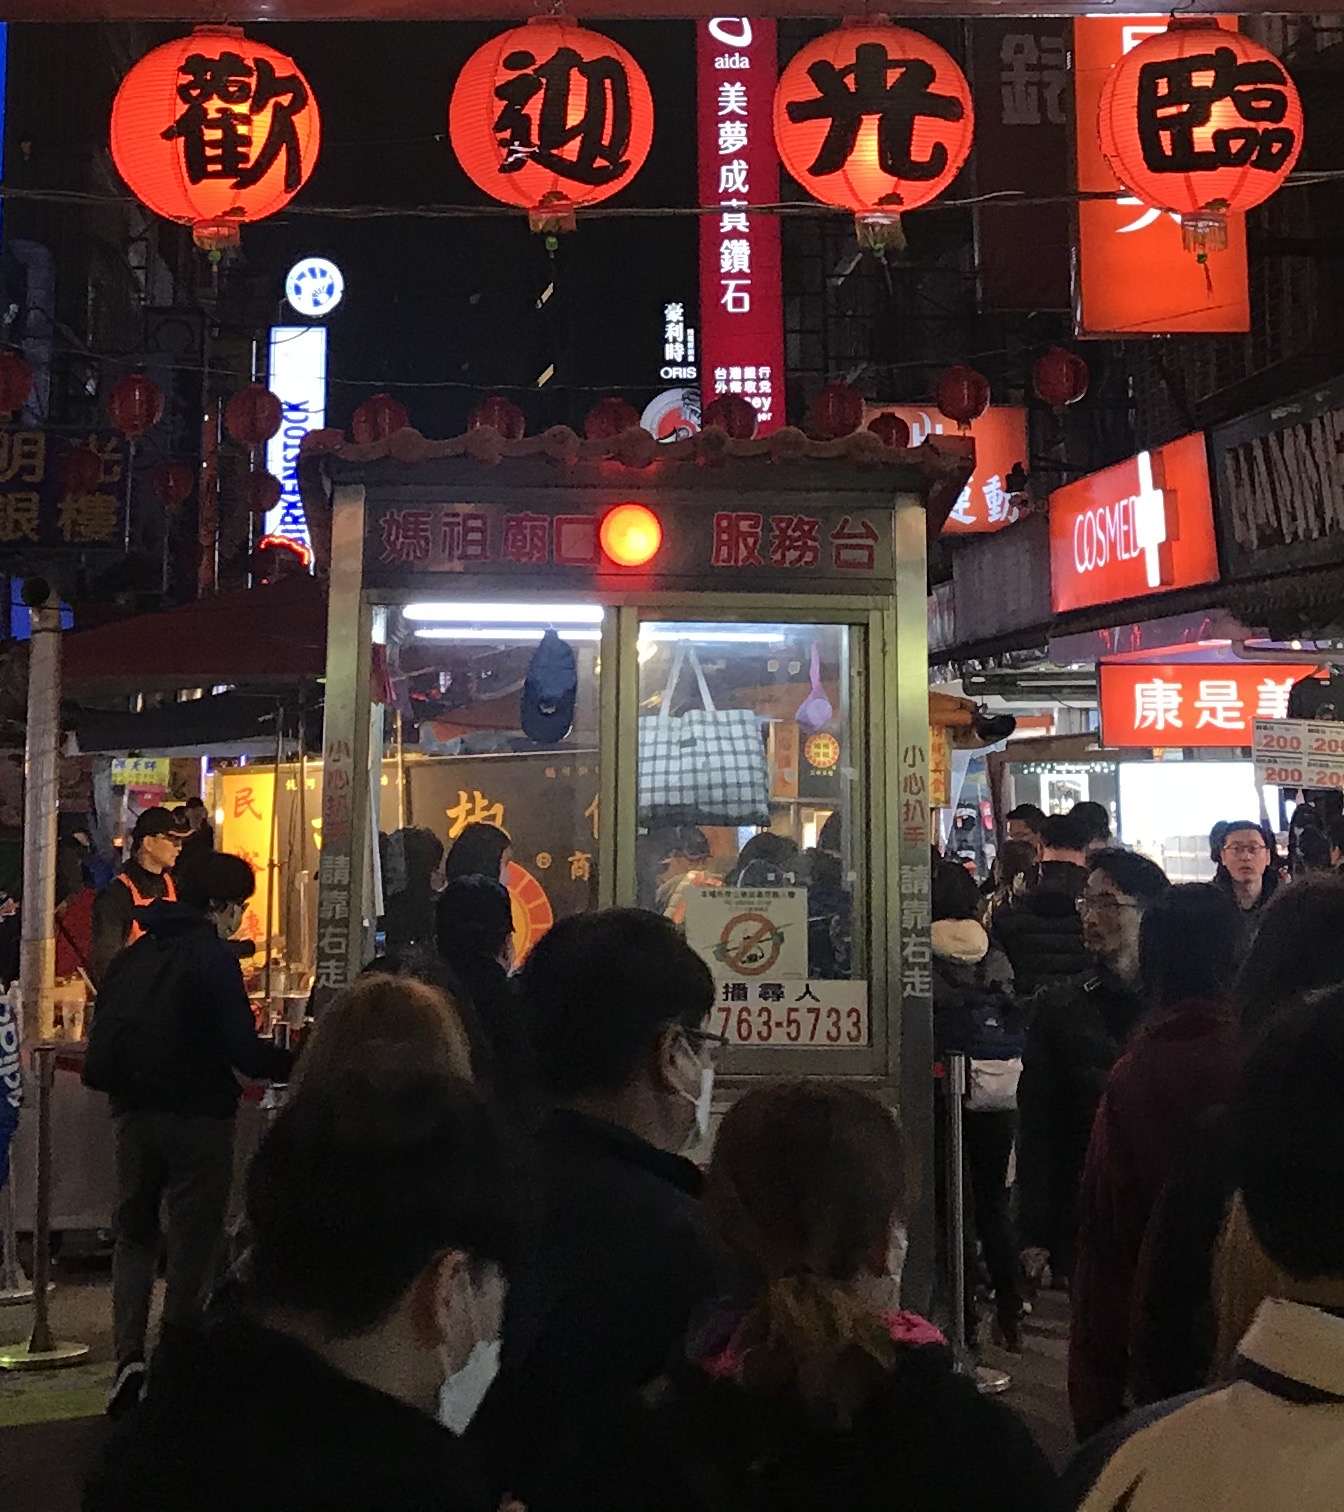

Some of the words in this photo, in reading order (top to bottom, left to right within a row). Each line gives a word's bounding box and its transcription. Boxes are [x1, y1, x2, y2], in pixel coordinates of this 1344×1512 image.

[714, 53, 750, 70] aida
[160, 53, 310, 193] 歡
[494, 48, 632, 186] 迎
[786, 43, 964, 181] 光
[1137, 47, 1296, 174] 臨
[717, 81, 751, 314] 美夢成真鑽石
[660, 366, 697, 379] ORIS
[711, 511, 880, 569] 服務台
[1074, 493, 1143, 574] COSMED
[1262, 734, 1302, 751] 200
[1264, 766, 1303, 783] 200
[706, 1006, 862, 1043] 763-5733
